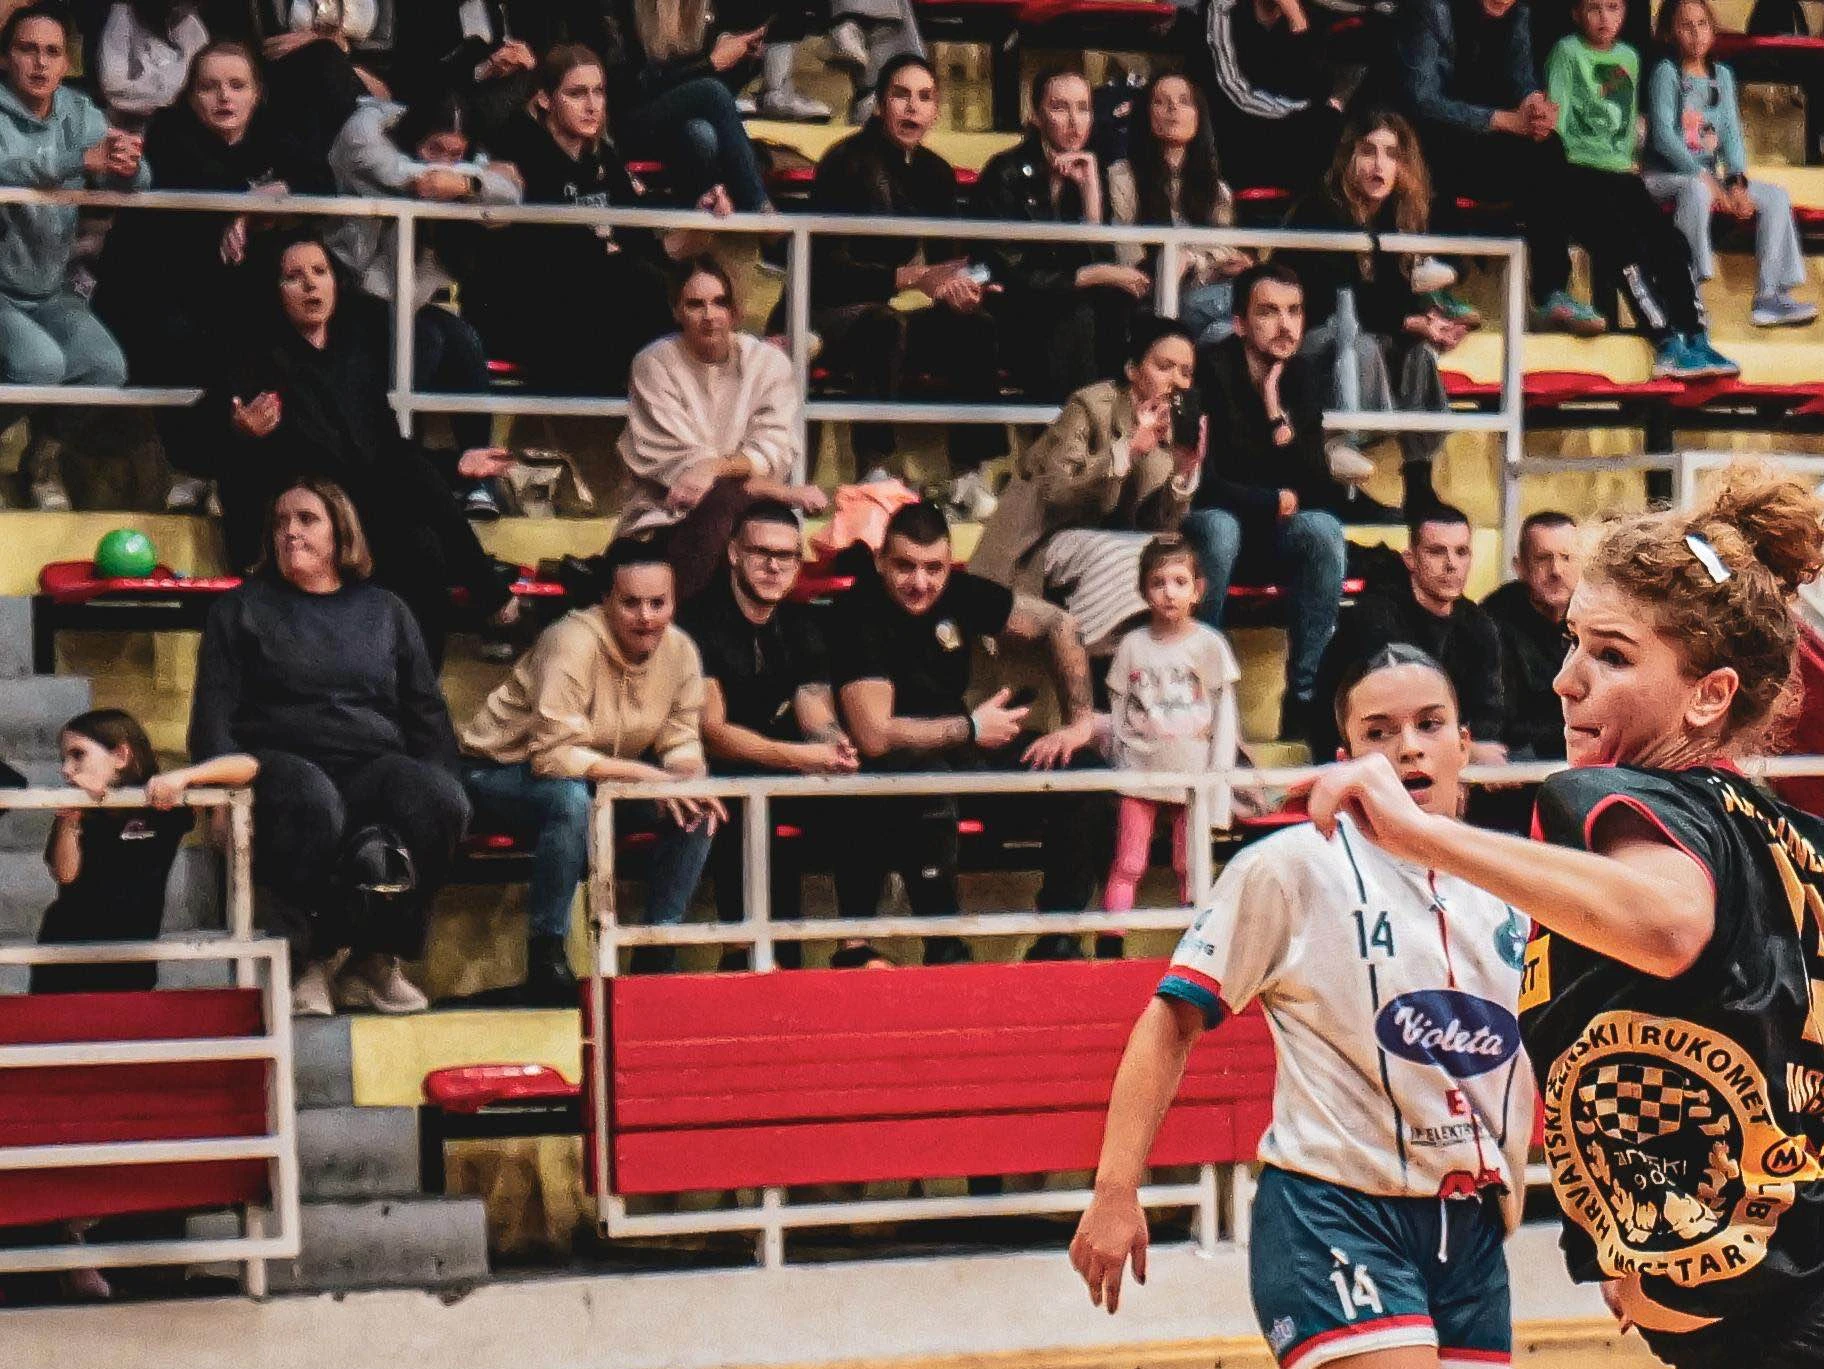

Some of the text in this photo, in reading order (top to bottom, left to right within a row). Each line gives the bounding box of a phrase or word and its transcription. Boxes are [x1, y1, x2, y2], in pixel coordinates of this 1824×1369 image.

[1353, 910, 1395, 959] 14
[1394, 1005, 1504, 1056] Violeta
[1329, 1263, 1383, 1320] 14
